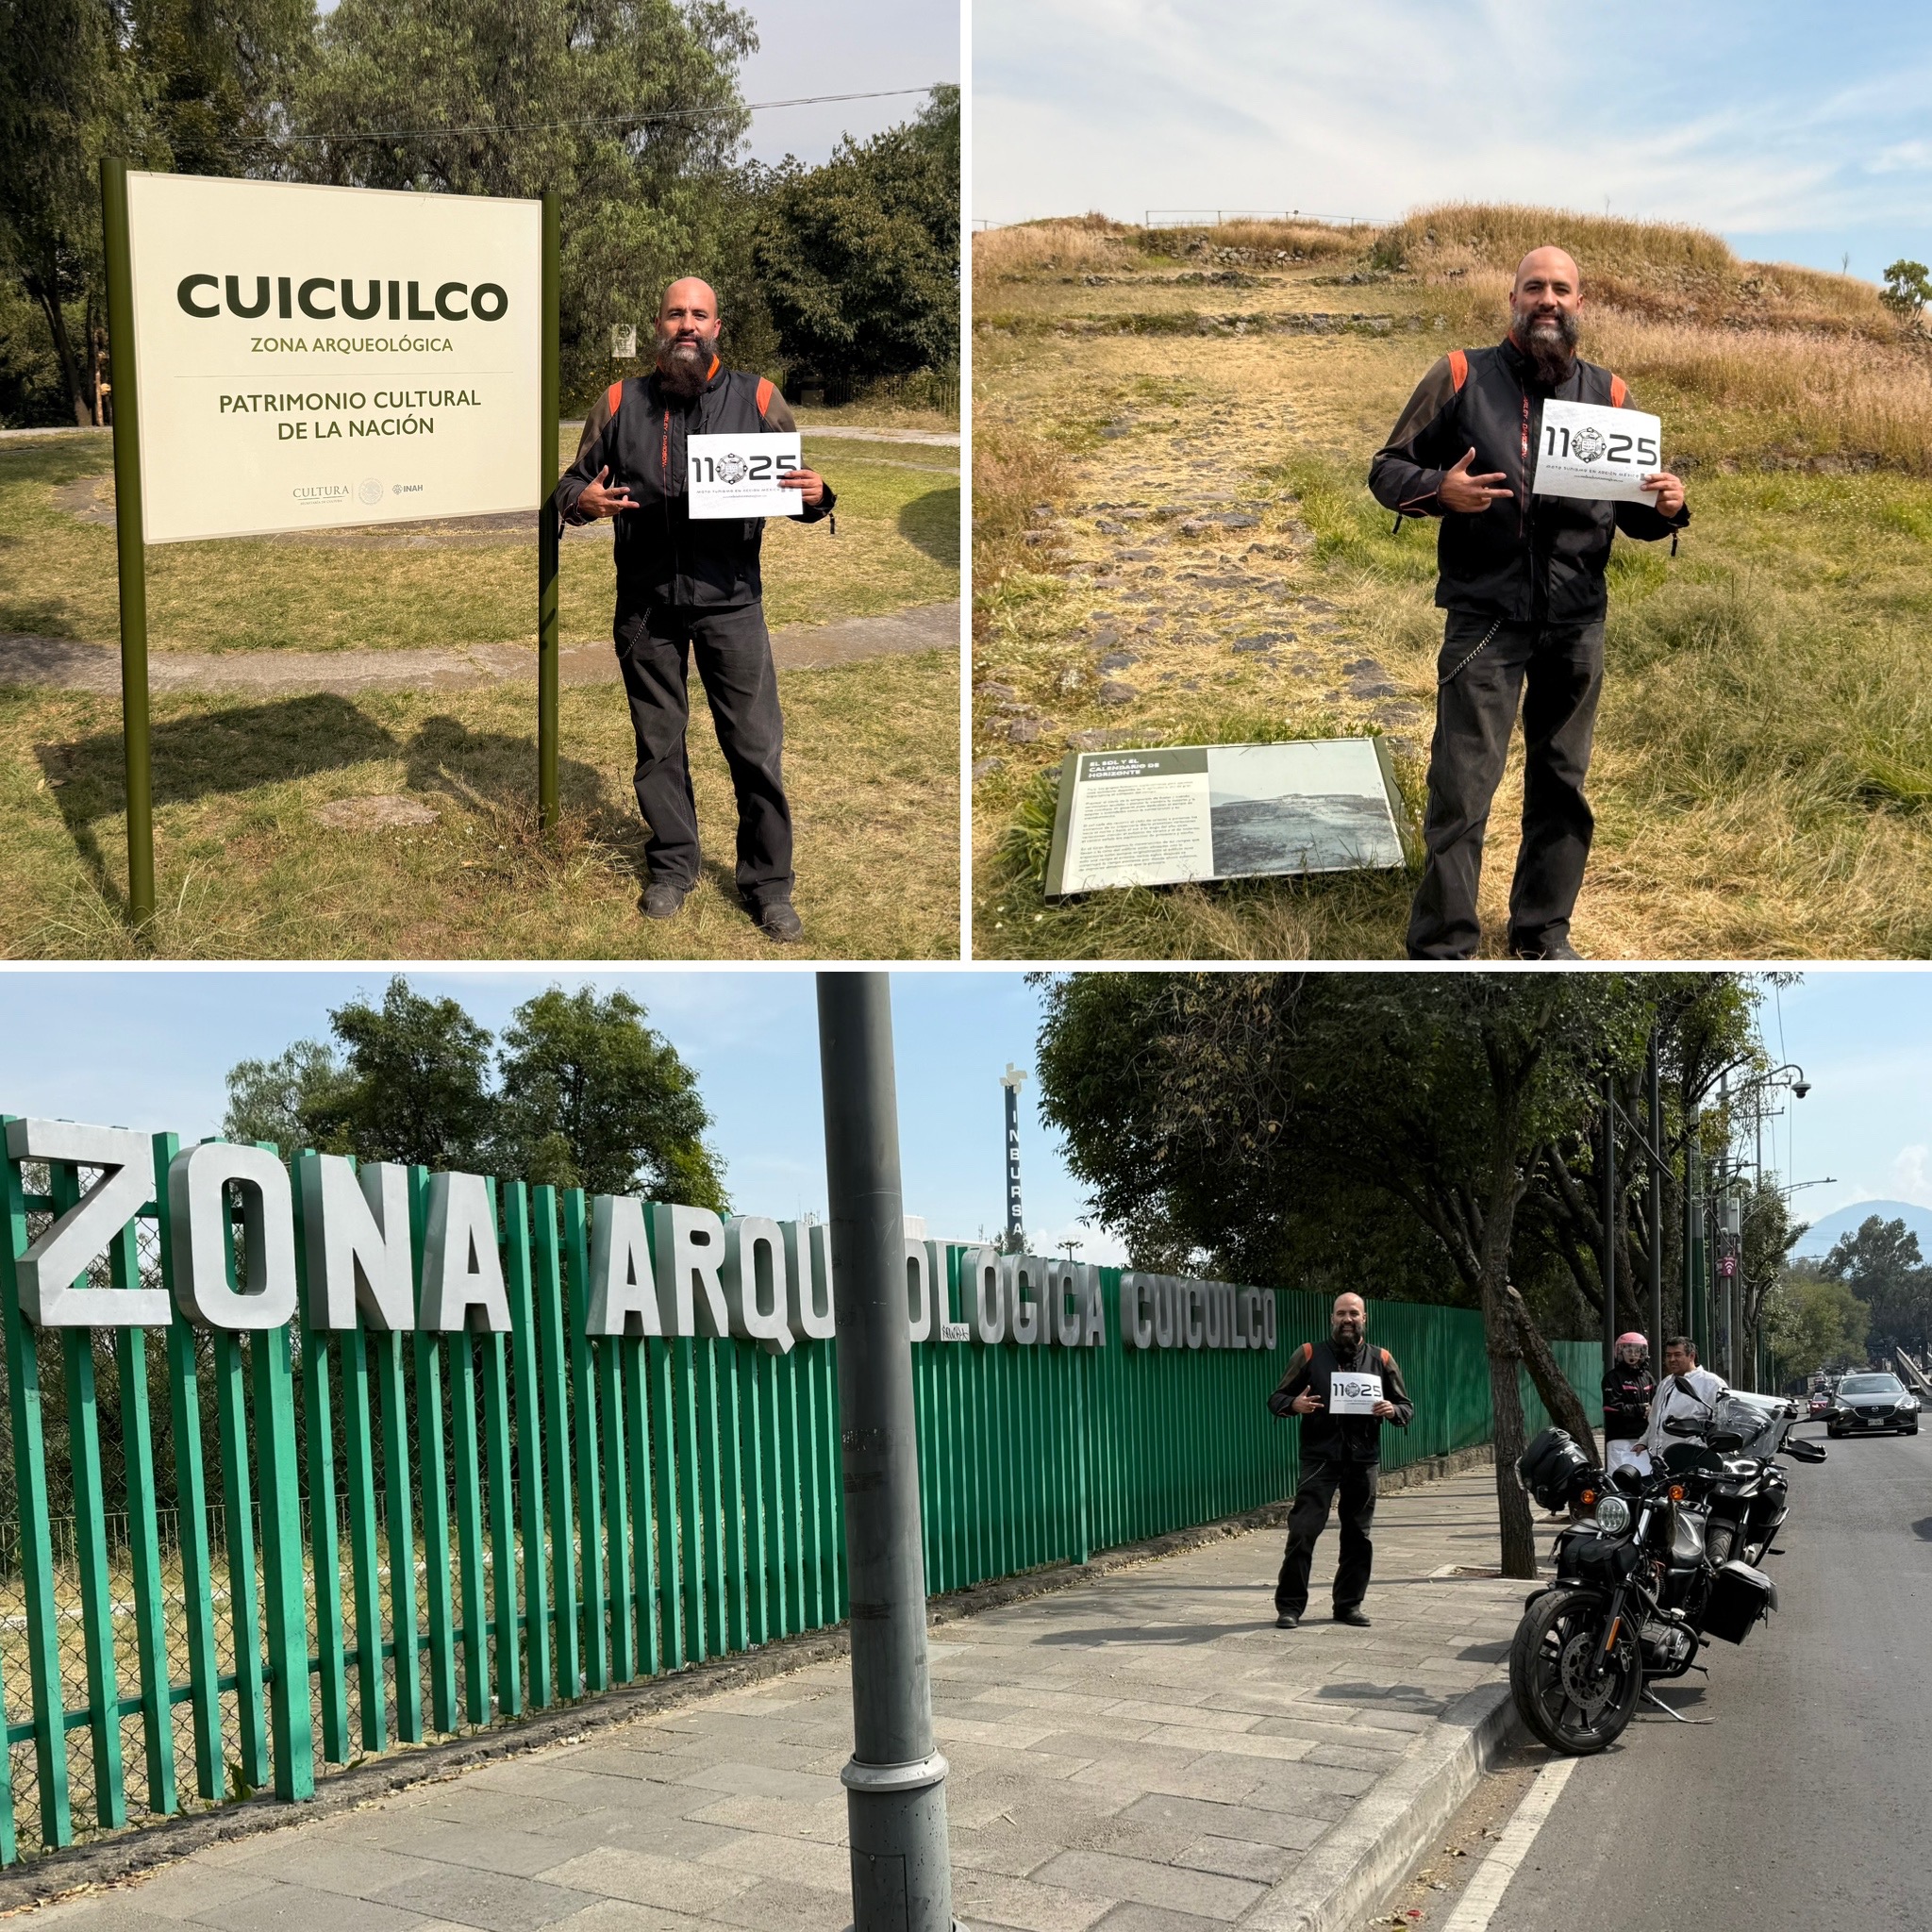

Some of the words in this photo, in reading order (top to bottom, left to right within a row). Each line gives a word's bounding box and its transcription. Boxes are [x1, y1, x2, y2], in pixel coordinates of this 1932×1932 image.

[176, 274, 508, 322] CUICUILCO
[251, 338, 308, 353] ZONA
[312, 335, 454, 354] ARQUEOLÓGICA
[220, 392, 366, 413] PATRIMONIO
[374, 390, 481, 408] CULTURAL
[278, 423, 308, 440] DE
[315, 422, 341, 439] LA
[349, 414, 434, 437] NACIÓN
[292, 486, 349, 497] CULTURA
[403, 484, 424, 492] INAH
[1088, 769, 1141, 778] HORIZONTE
[1089, 763, 1146, 773] CALENDARIO
[1009, 1110, 1023, 1235] INBURSA
[5, 1118, 512, 1332] ZONA
[586, 1193, 1107, 1355] ARQUOLOGICA
[1120, 1272, 1277, 1350] CUICUILCO
